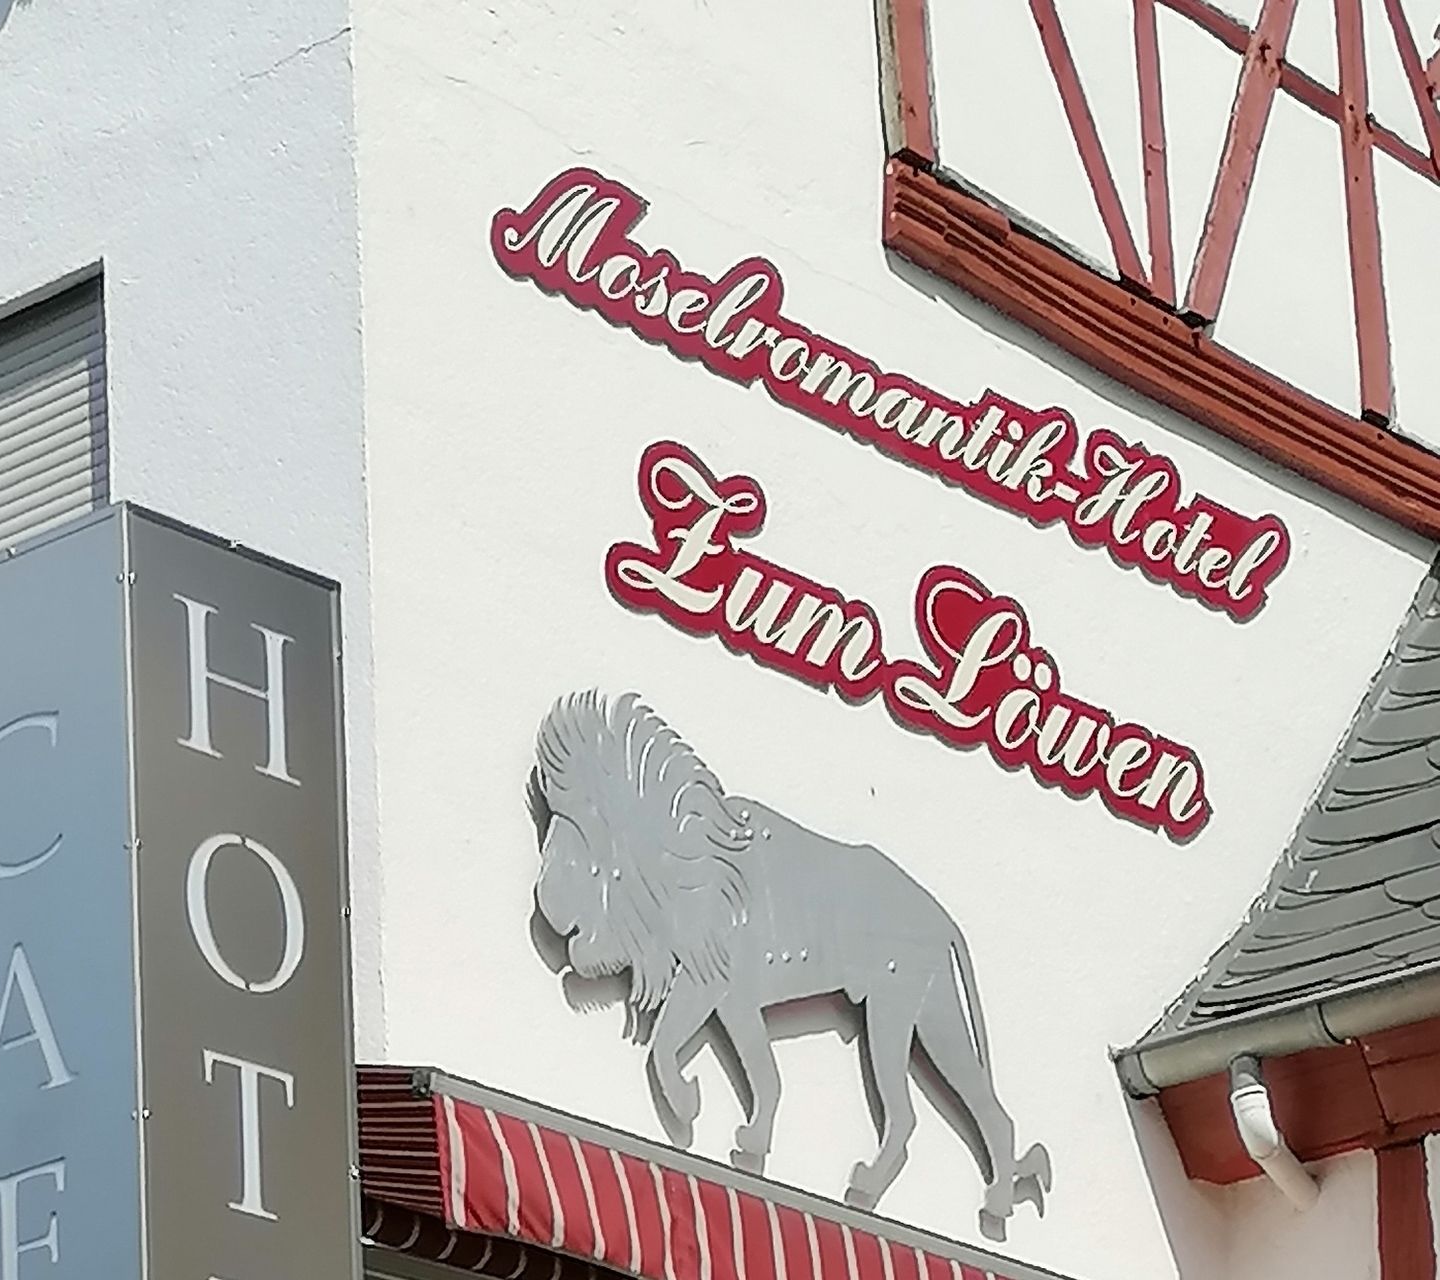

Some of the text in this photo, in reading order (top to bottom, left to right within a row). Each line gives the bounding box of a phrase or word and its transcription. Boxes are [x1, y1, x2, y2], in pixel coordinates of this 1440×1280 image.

[503, 183, 1283, 600] Moselromantik-Hotel
[616, 454, 1203, 824] Zum Löwen
